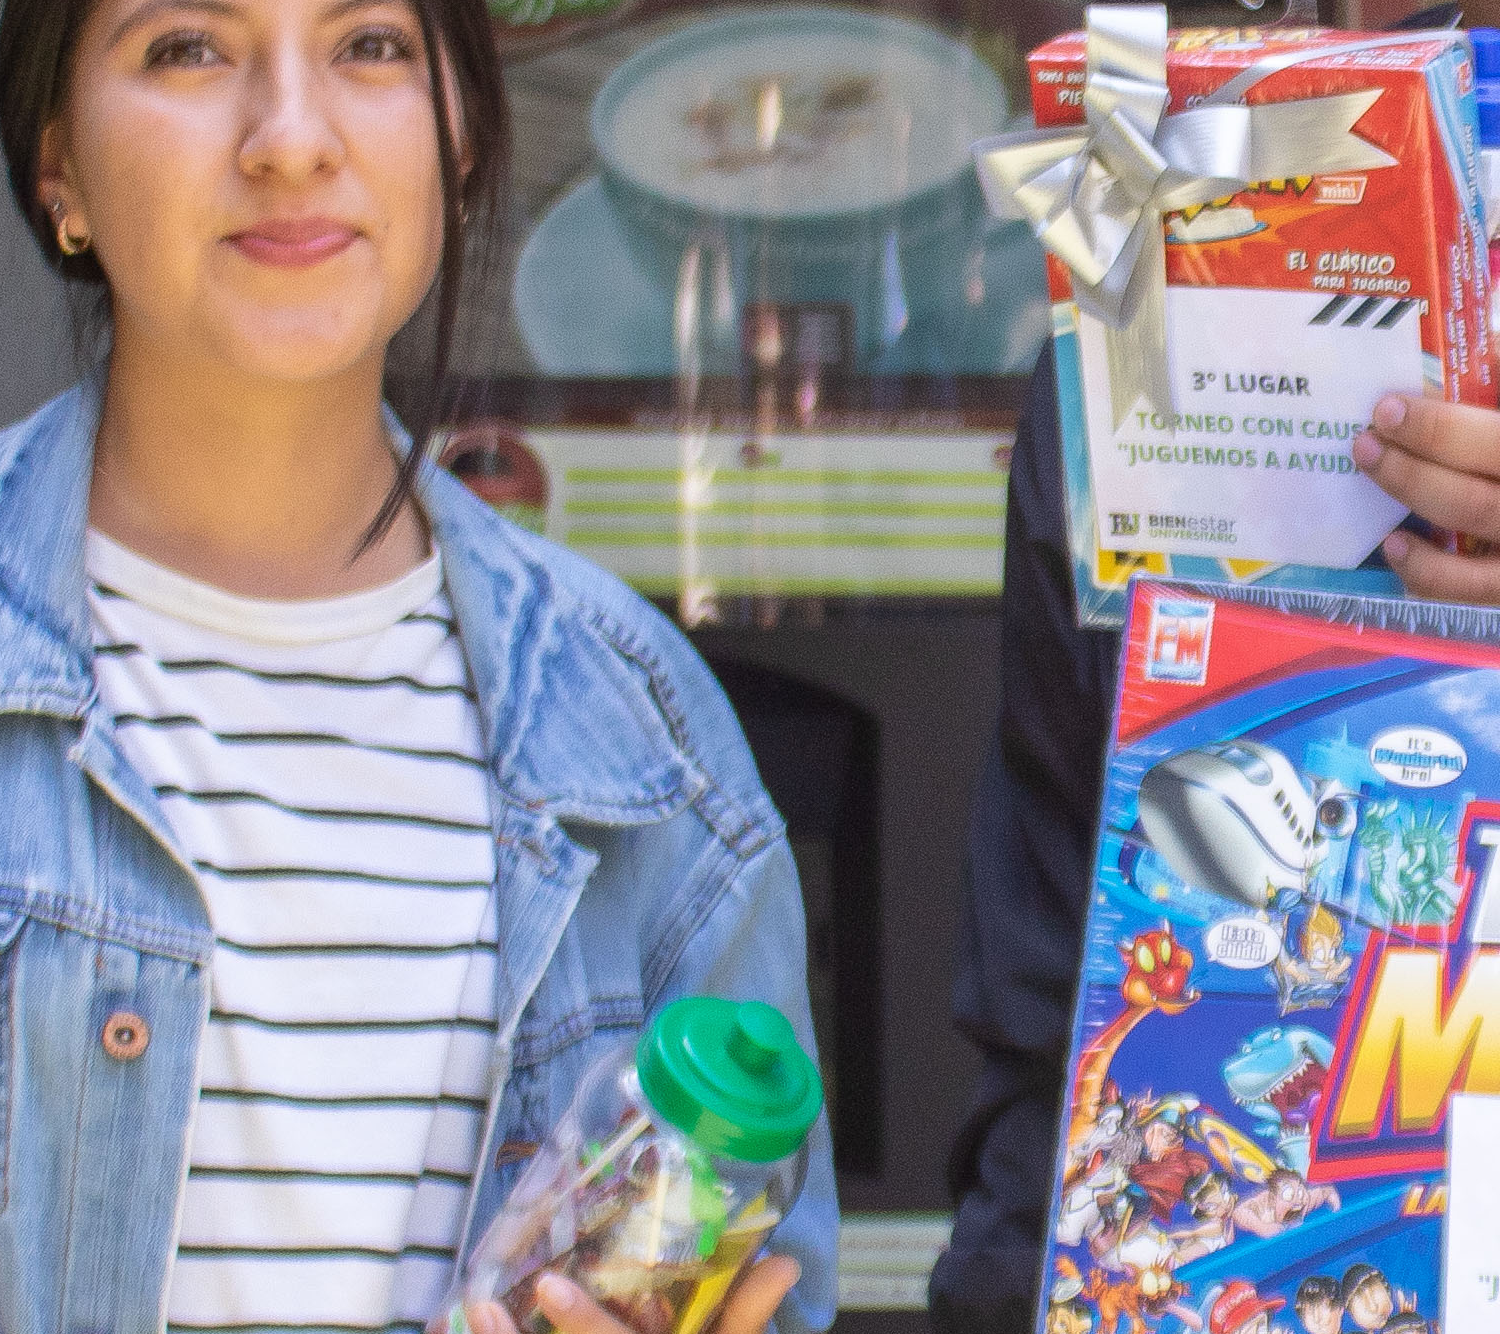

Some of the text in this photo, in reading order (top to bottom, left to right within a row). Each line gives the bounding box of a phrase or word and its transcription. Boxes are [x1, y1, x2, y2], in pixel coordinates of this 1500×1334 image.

[1321, 181, 1358, 199] mini
[1288, 251, 1308, 271] EL
[1225, 372, 1311, 397] LUGAR
[1136, 411, 1233, 434] TORNEO
[1242, 415, 1294, 436] CON
[1264, 450, 1281, 469] A
[1149, 528, 1238, 544] UNIVERSITARIO
